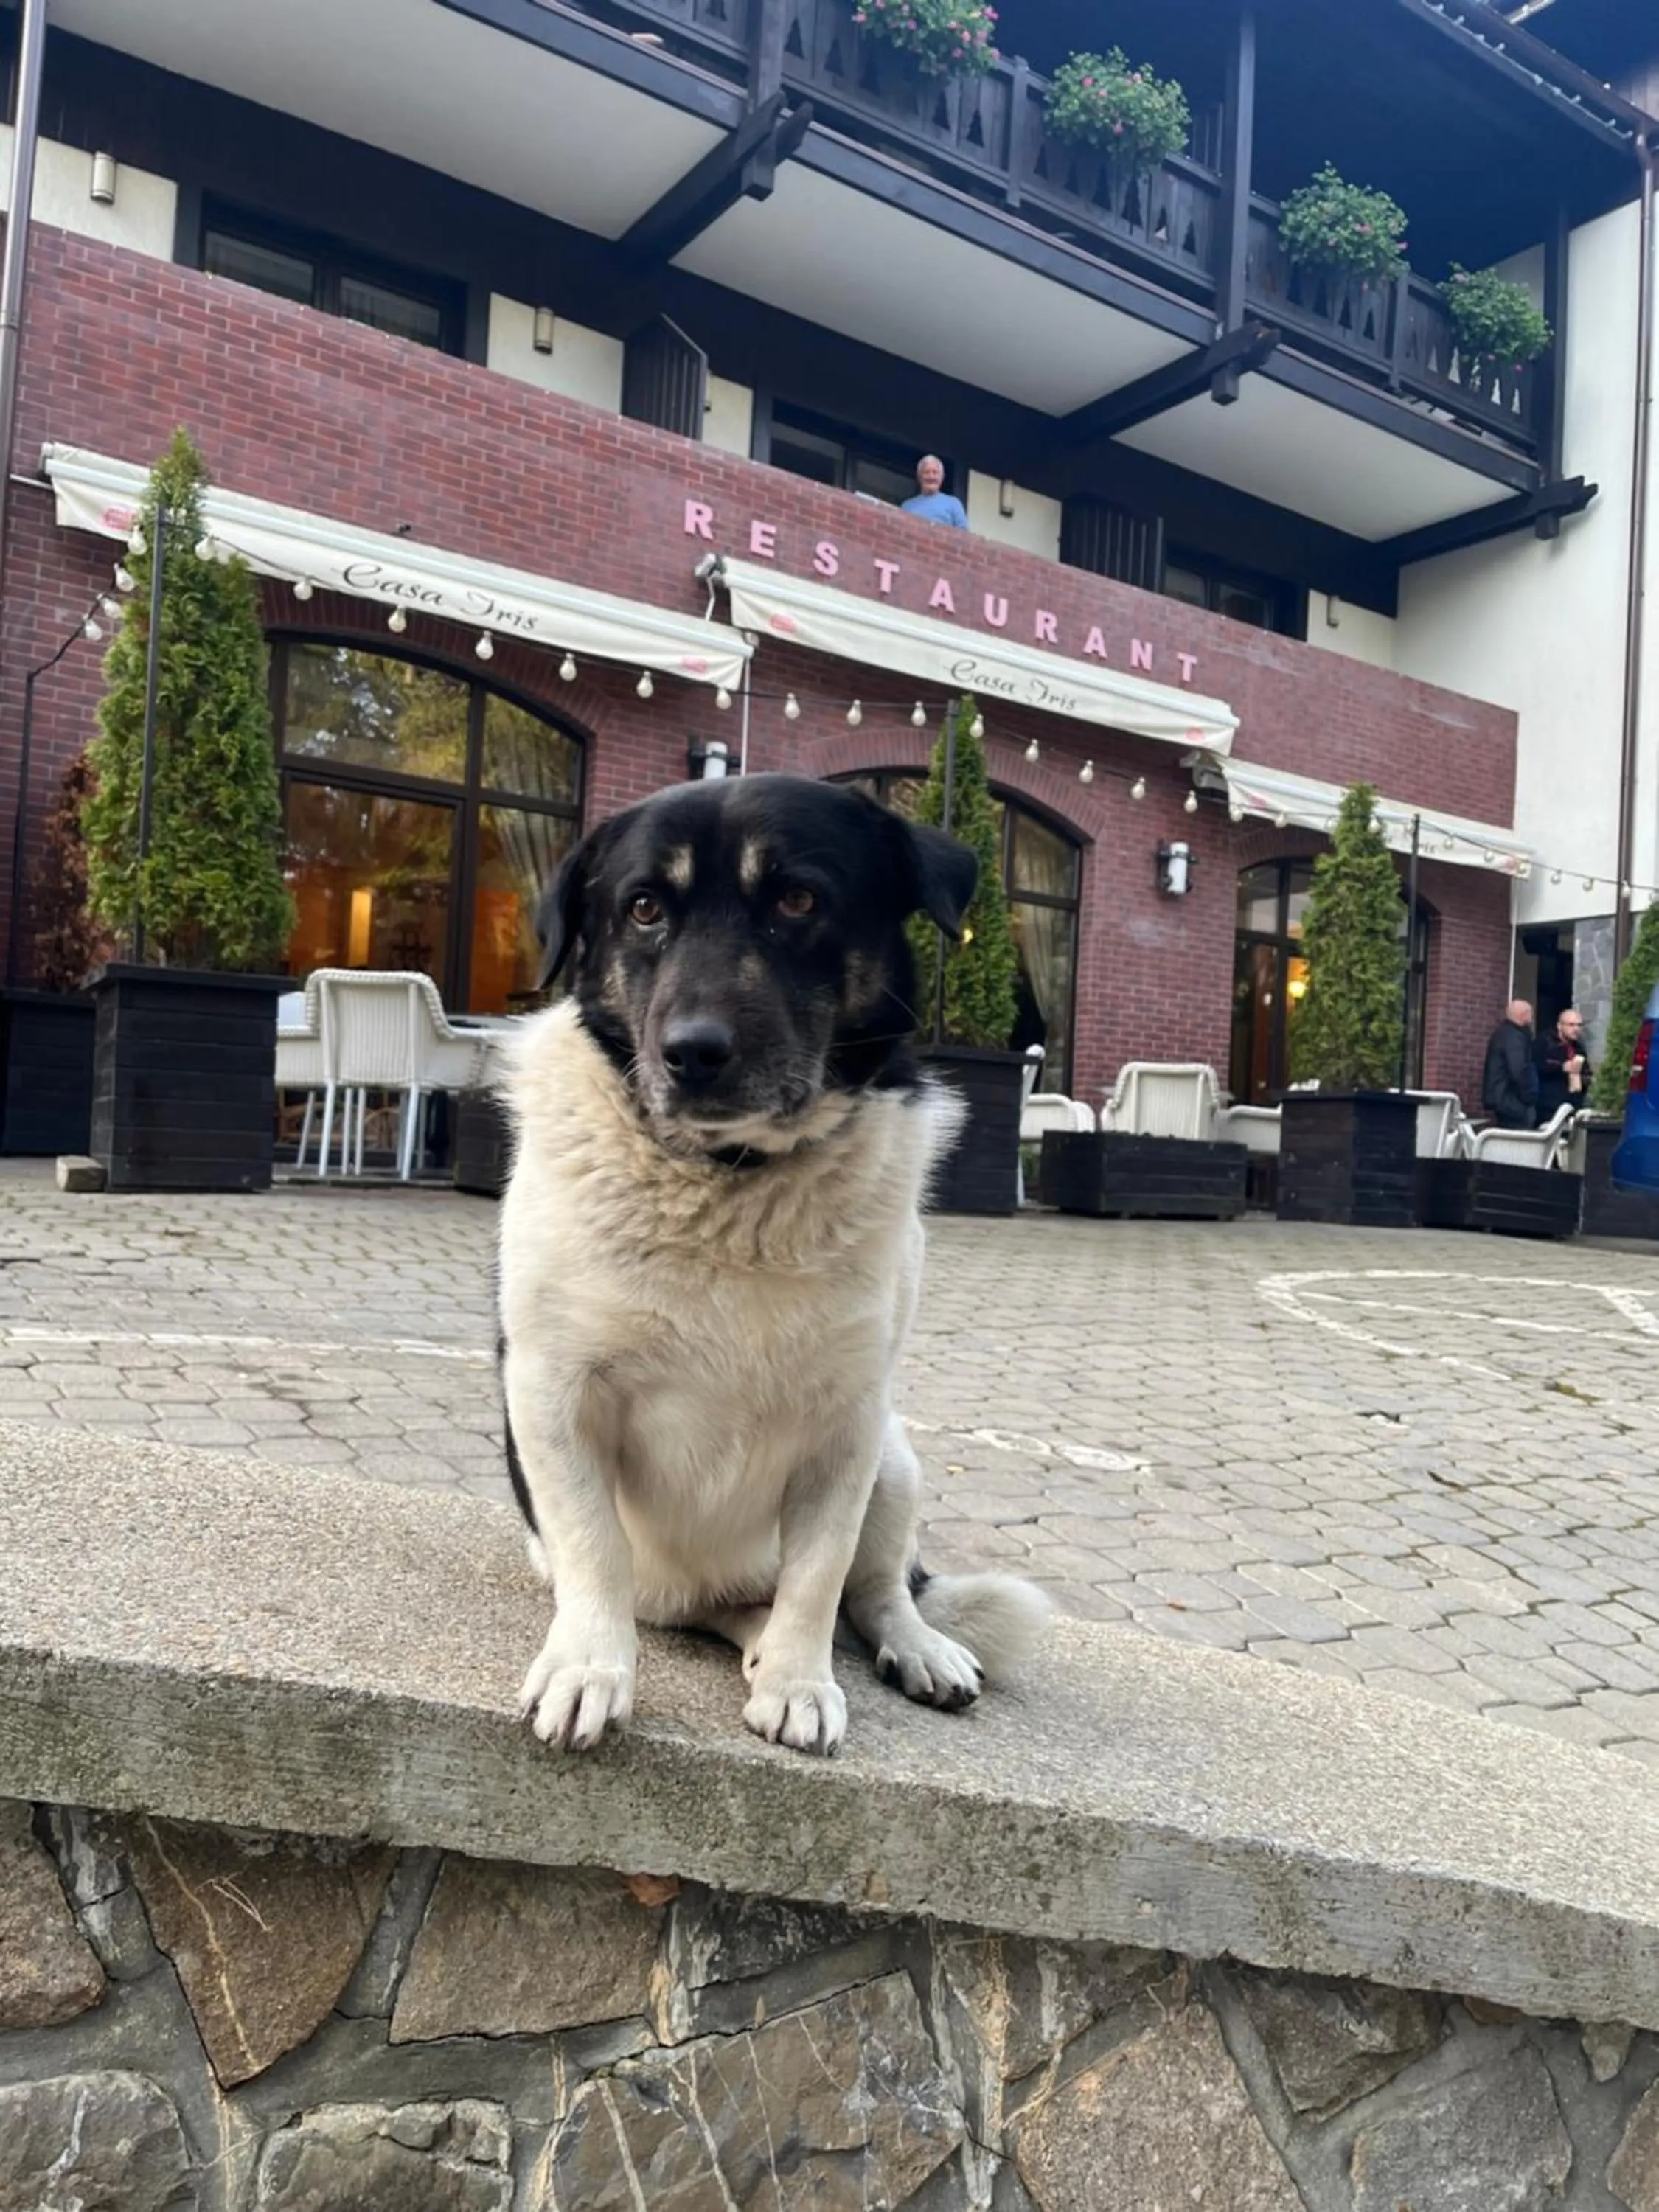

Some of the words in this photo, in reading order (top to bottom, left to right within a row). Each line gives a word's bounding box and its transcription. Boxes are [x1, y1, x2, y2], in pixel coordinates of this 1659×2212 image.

[332, 562, 443, 605] Casa
[460, 591, 539, 630] Iris
[684, 498, 1198, 683] RESTAURANT
[945, 658, 1016, 695] Casa
[1026, 677, 1077, 711] Iris
